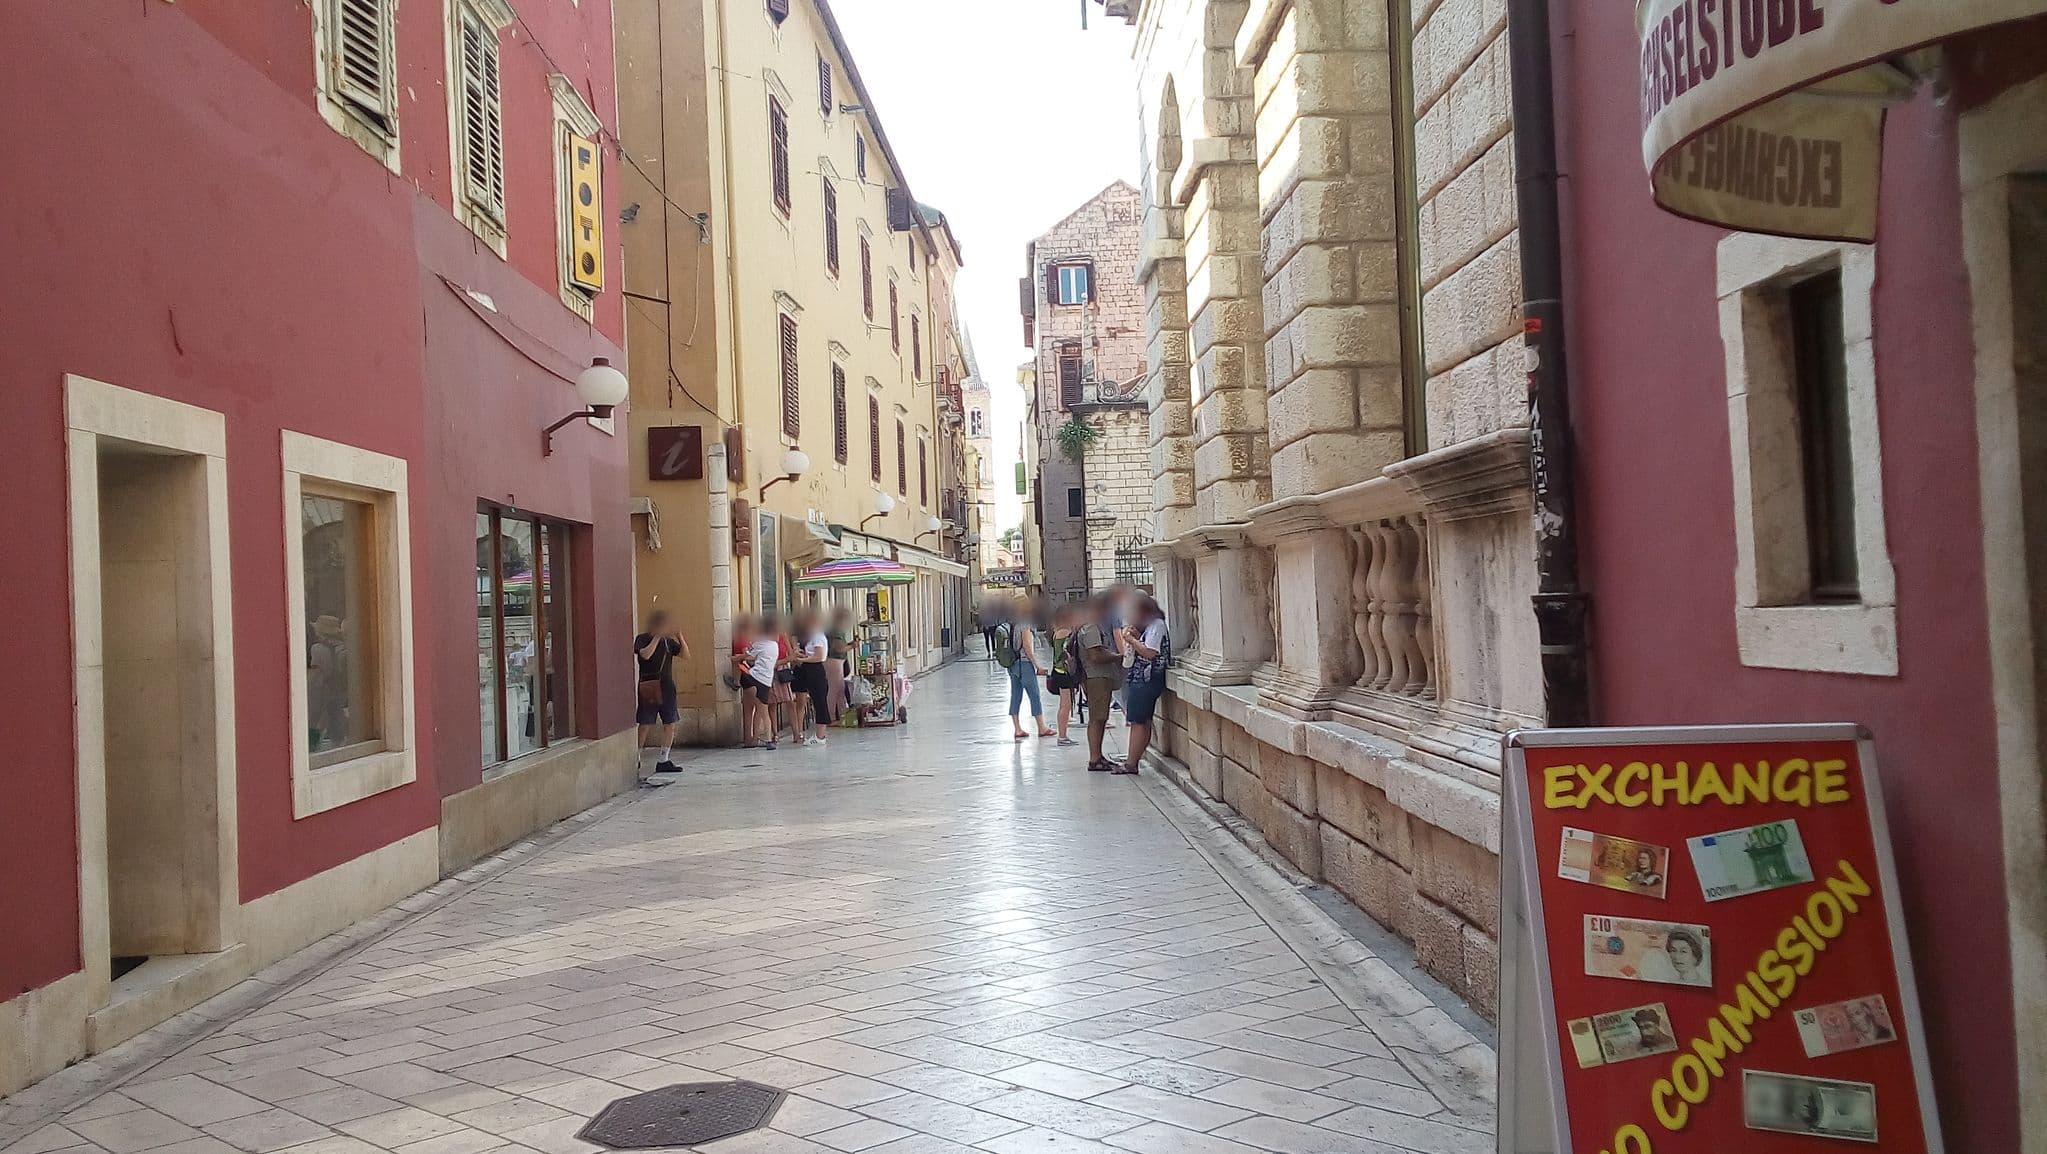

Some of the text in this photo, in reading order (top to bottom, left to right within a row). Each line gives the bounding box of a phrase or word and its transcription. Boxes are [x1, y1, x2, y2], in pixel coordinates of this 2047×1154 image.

[577, 146, 595, 276] FOTO
[1543, 758, 1849, 808] EXCHANGE
[1600, 859, 1871, 1154] O COMMISSION
